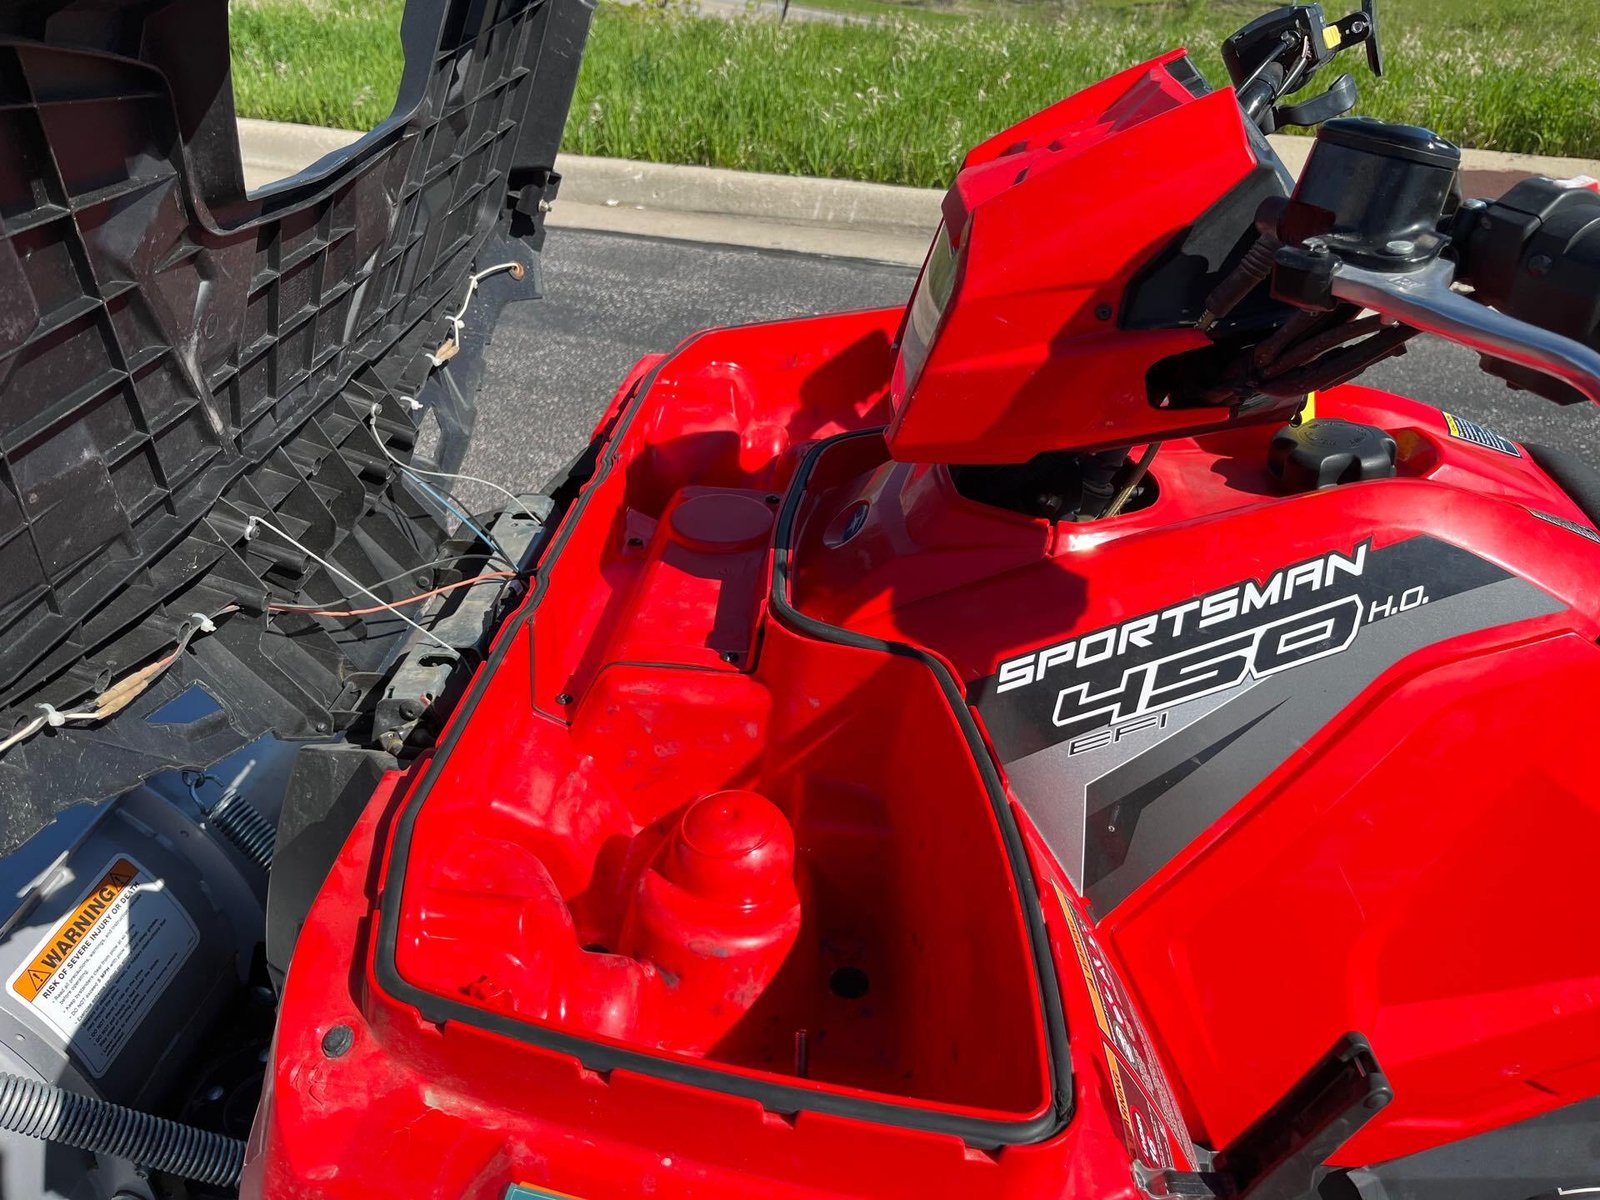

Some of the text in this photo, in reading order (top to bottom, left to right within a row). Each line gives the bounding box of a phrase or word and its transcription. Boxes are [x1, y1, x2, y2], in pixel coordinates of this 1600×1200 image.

[997, 544, 1367, 693] SPORTSMAN
[1052, 585, 1430, 728] 450 H.O.
[1067, 711, 1168, 758] EFI
[40, 882, 116, 973] WARNING
[41, 879, 140, 1000] RISK OF SEVERE INJURY OR DEATH
